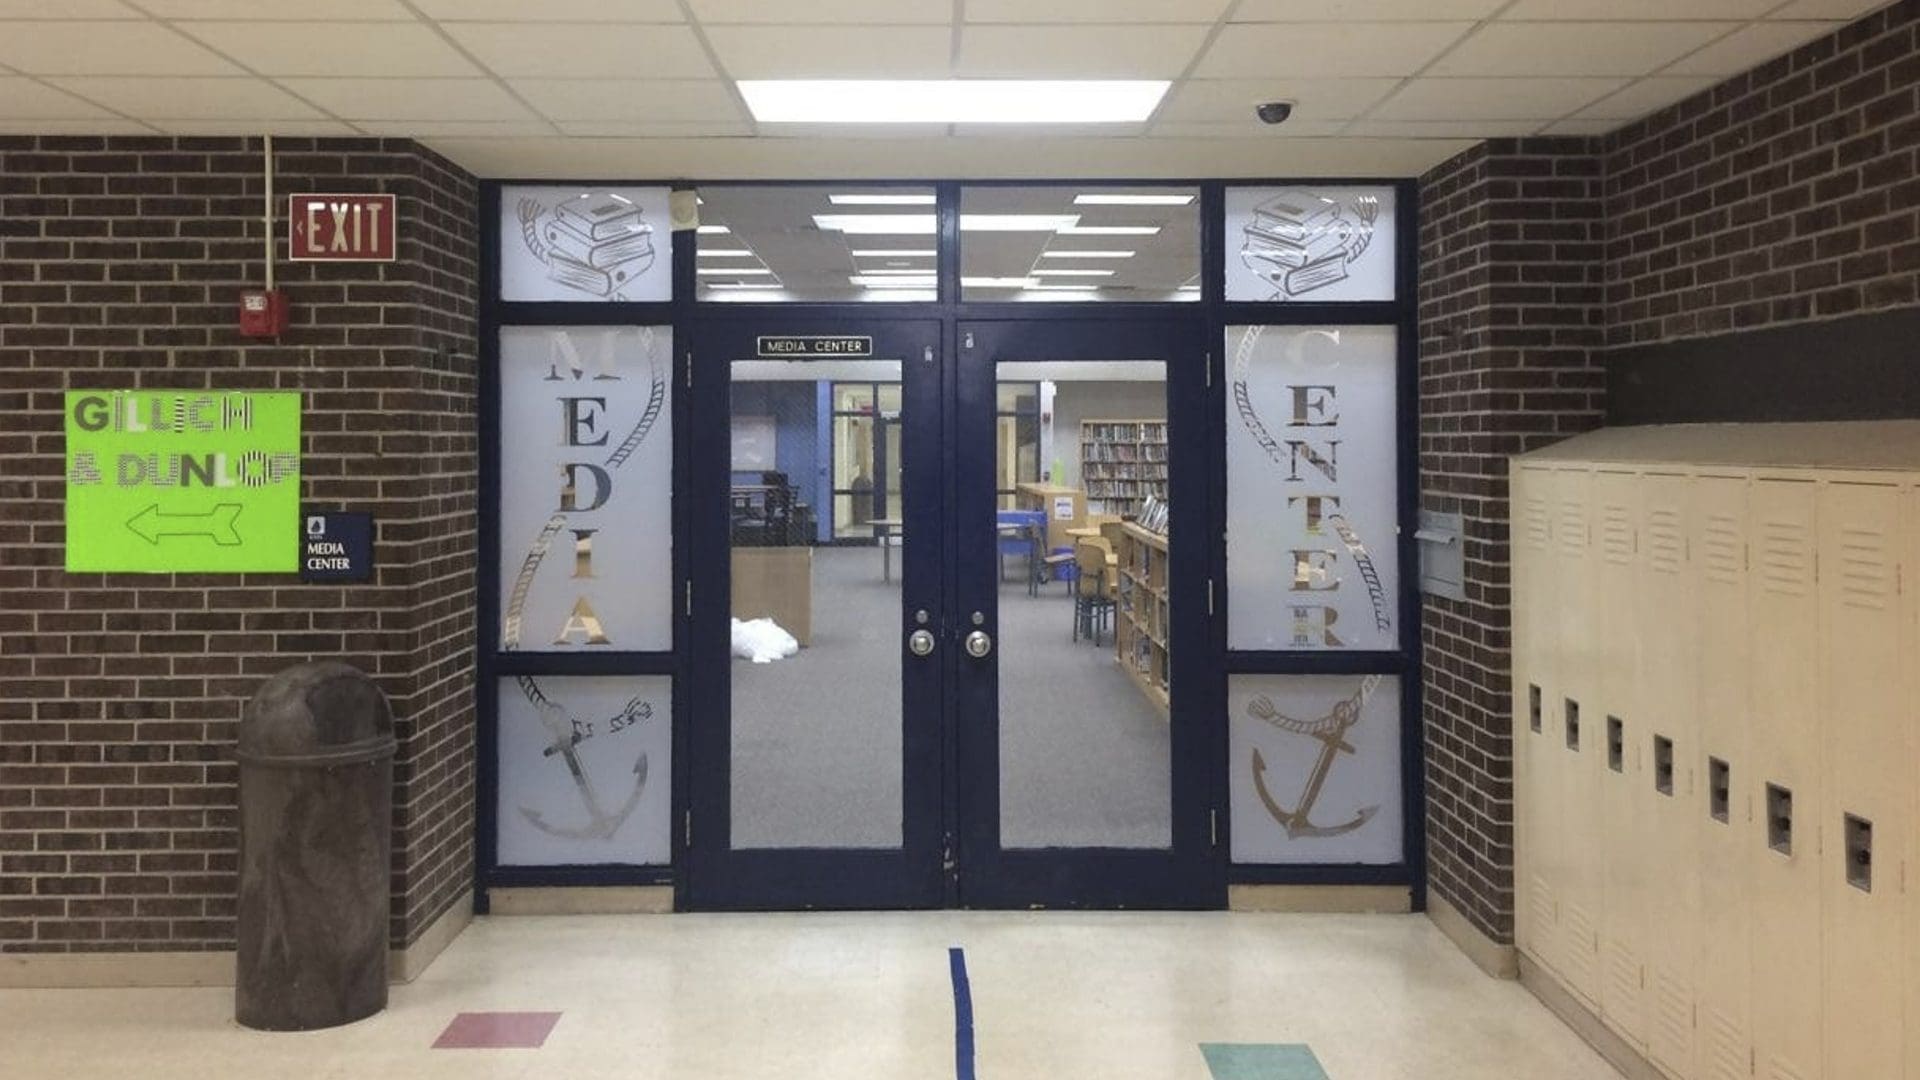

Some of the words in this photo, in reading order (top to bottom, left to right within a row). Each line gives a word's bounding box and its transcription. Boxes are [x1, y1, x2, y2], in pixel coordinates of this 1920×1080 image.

[307, 202, 383, 252] EXIT
[767, 341, 806, 352] MEDIA
[814, 341, 862, 352] CENTER
[74, 396, 253, 434] GILLICH
[69, 452, 103, 487] &
[116, 450, 299, 488] DUNLOP
[1285, 329, 1346, 647] CENTER
[544, 331, 621, 646] MEDIA
[307, 558, 350, 570] CENTER
[308, 542, 345, 555] MEDIA
